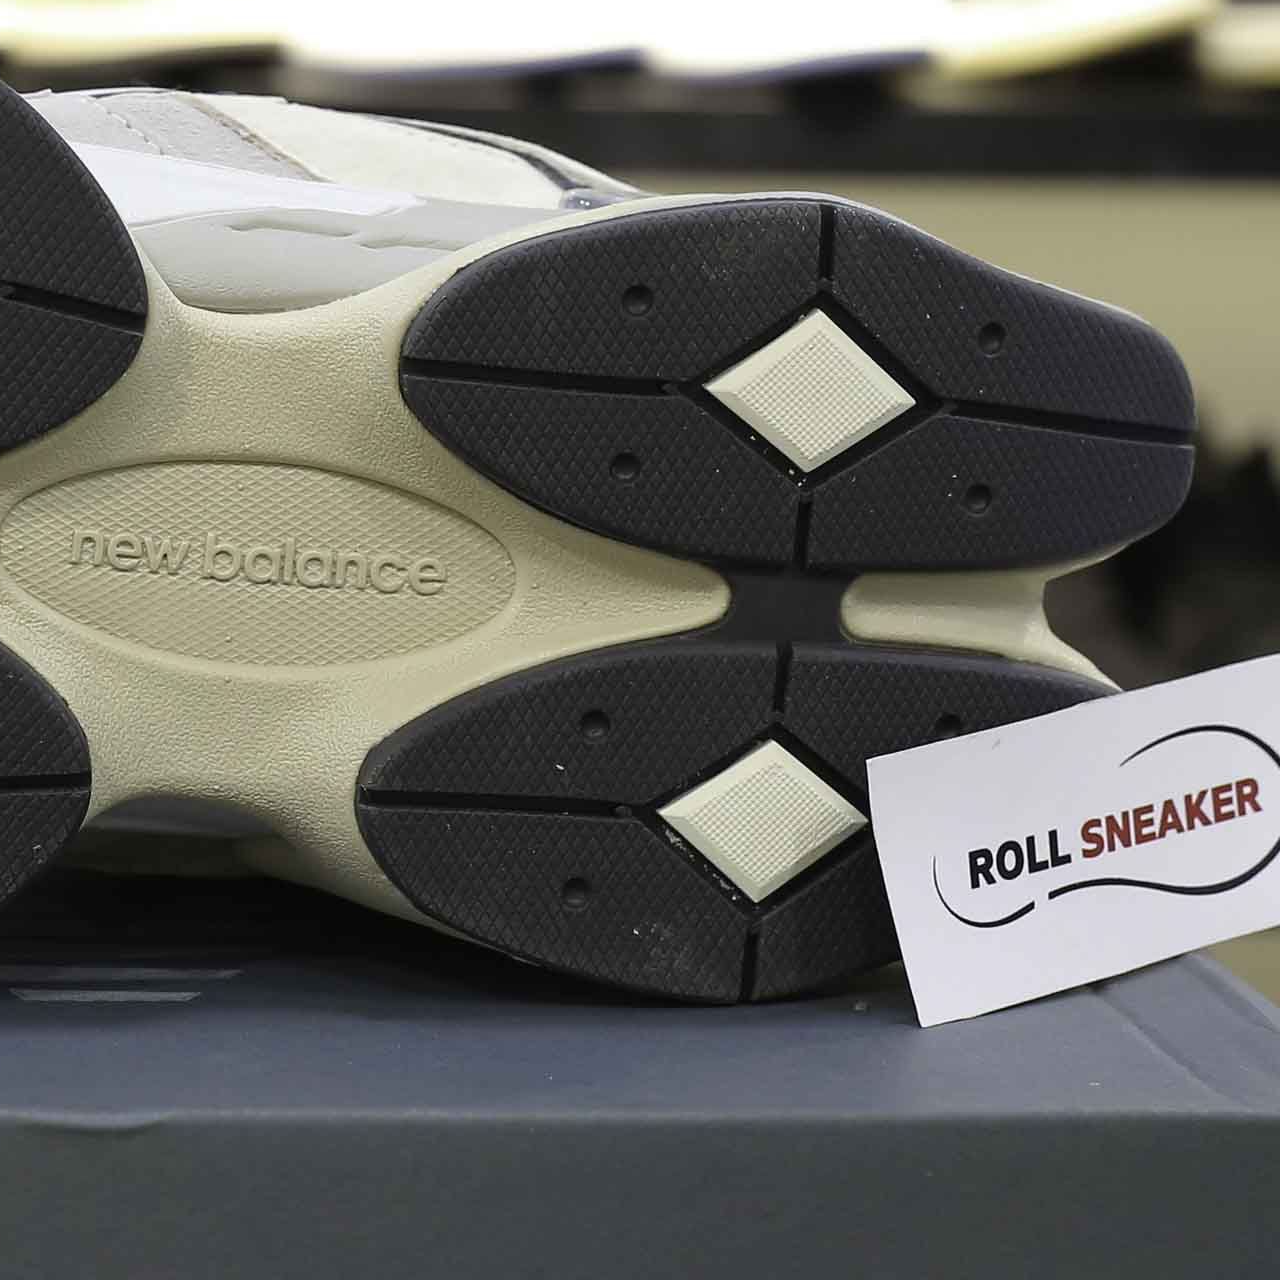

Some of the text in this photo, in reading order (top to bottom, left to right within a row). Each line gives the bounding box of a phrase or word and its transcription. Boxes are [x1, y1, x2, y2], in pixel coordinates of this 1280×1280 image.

[70, 527, 448, 595] new balance
[968, 777, 1262, 889] ROLL SNEAKER
